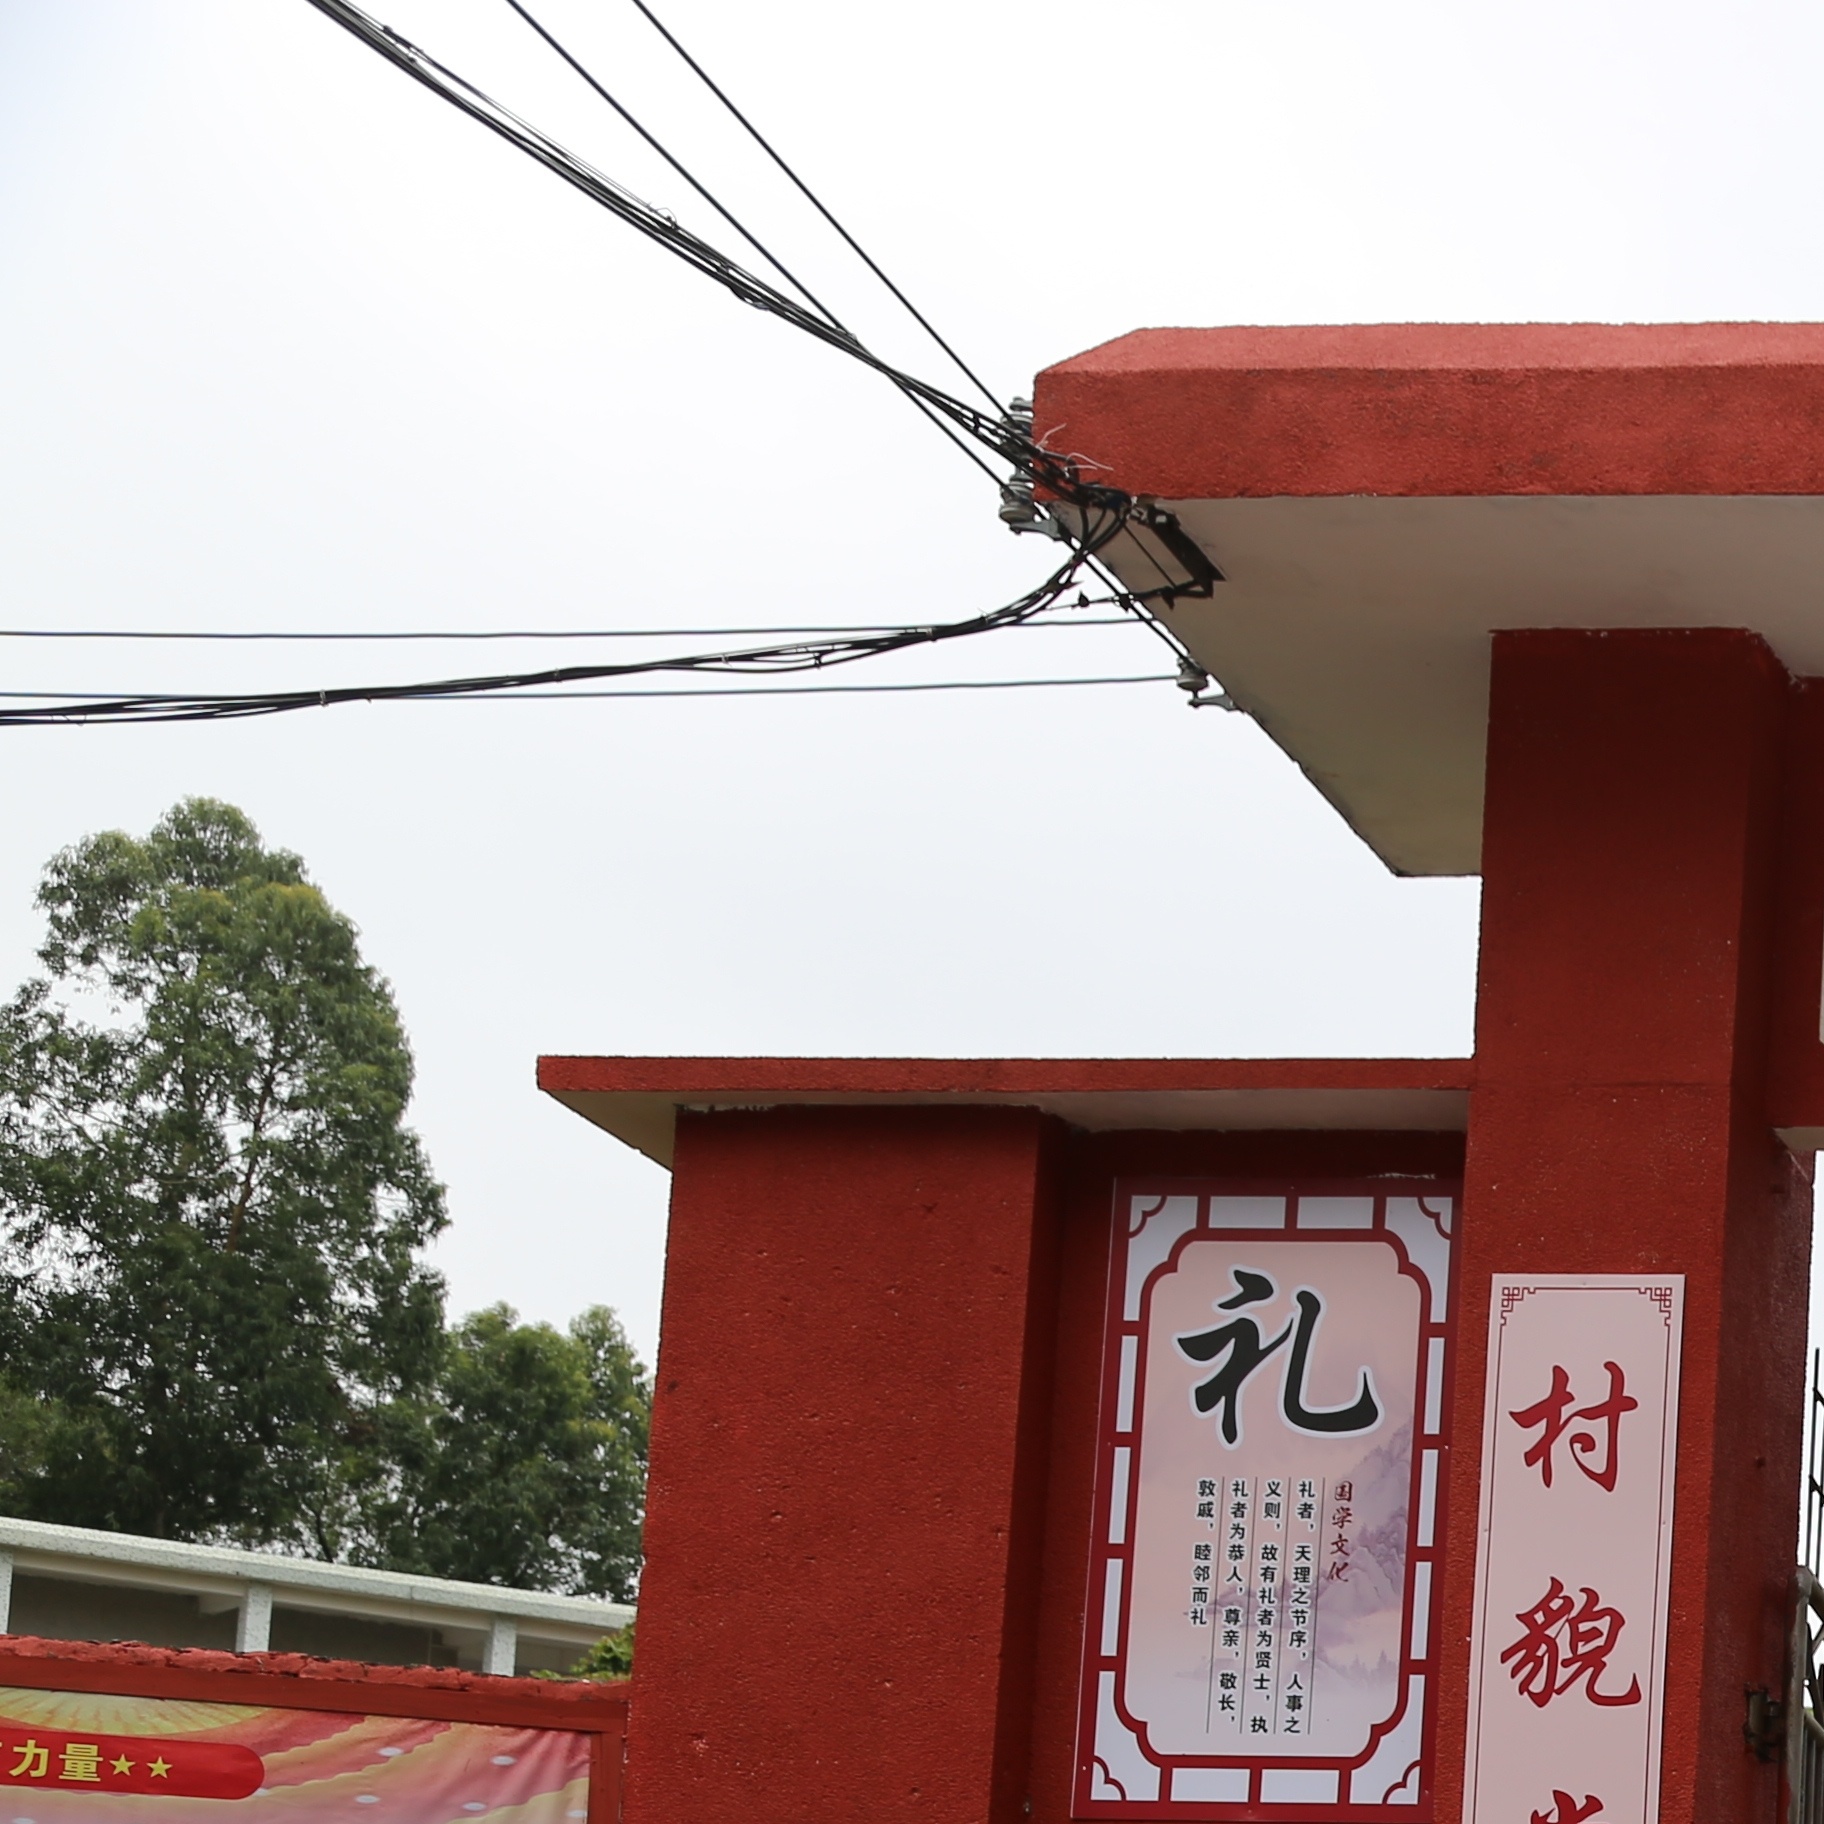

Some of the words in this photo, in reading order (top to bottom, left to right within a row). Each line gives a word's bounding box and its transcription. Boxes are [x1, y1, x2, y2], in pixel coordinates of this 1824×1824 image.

[1176, 1268, 1380, 1445] 礼
[1327, 1480, 1353, 1583] 国学文化
